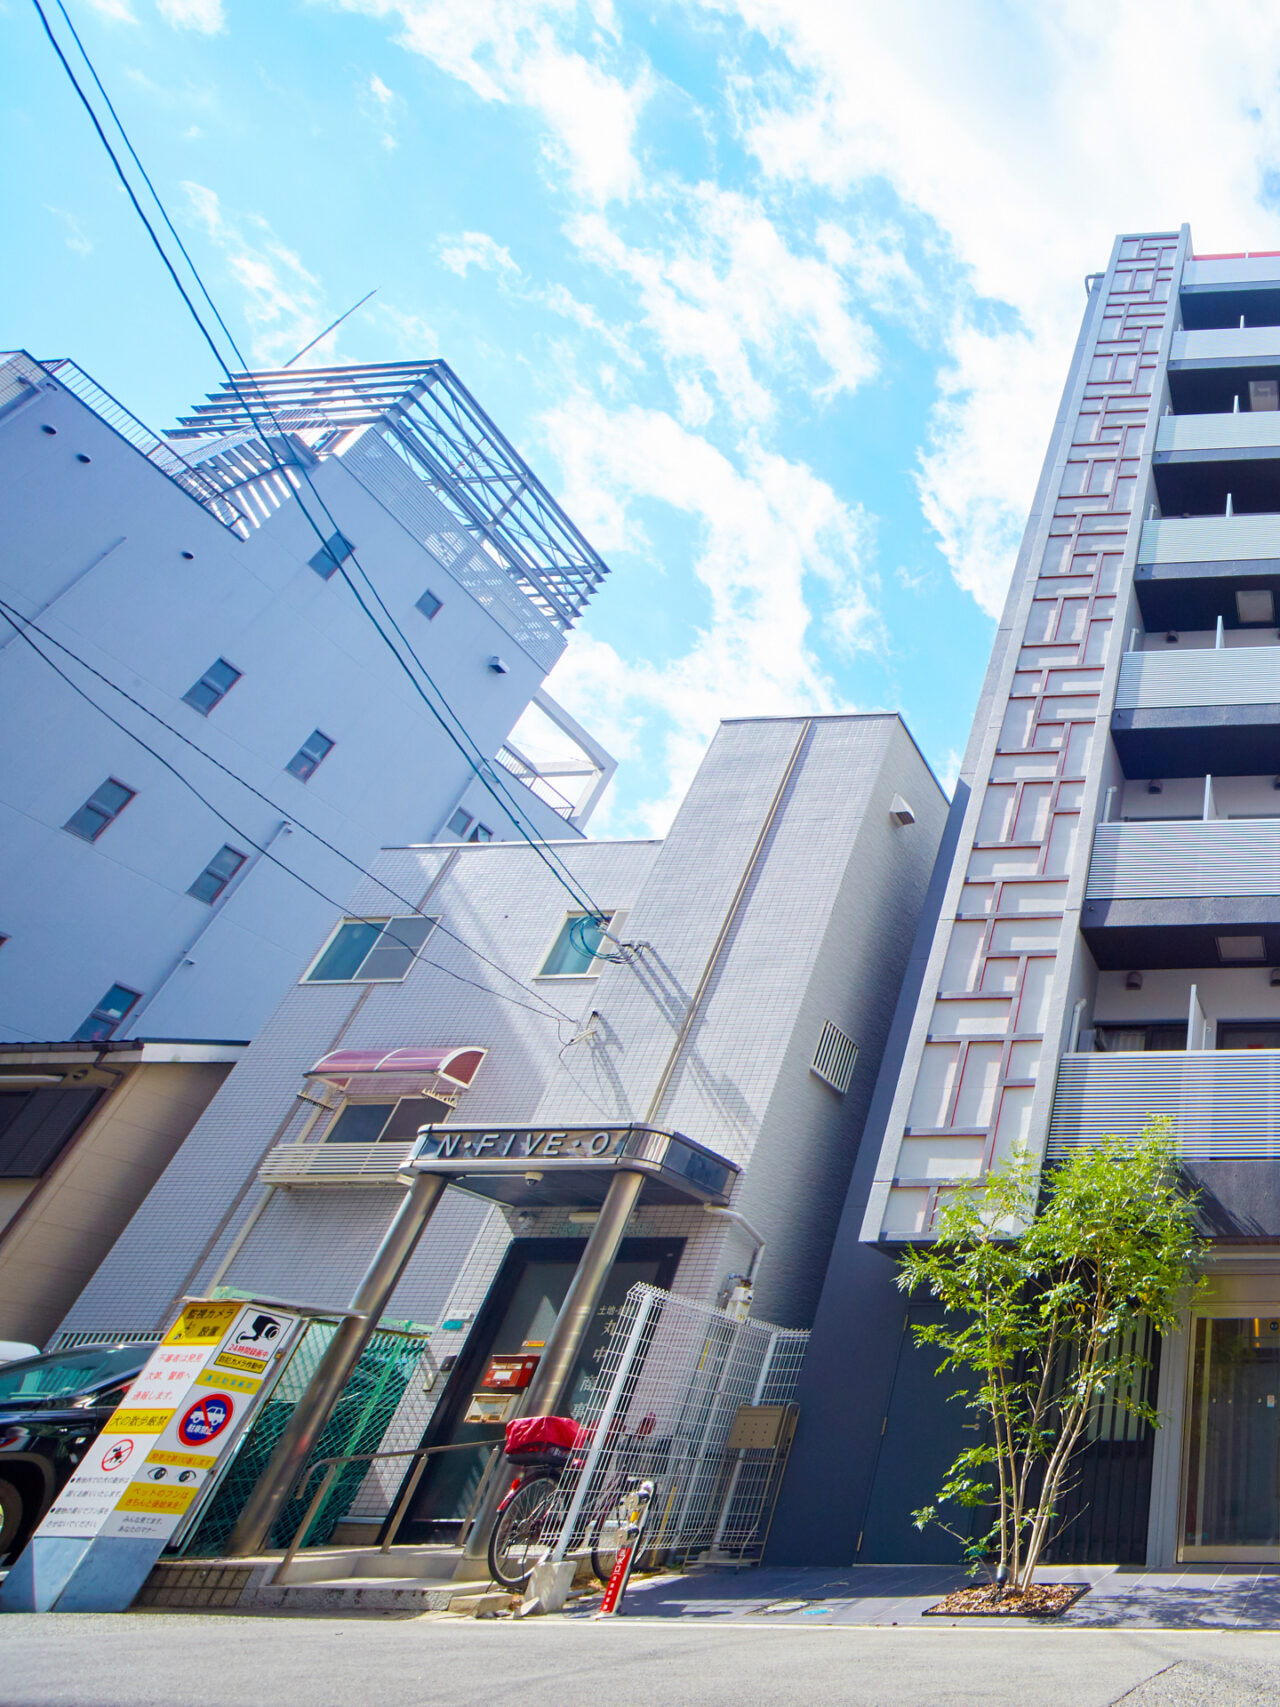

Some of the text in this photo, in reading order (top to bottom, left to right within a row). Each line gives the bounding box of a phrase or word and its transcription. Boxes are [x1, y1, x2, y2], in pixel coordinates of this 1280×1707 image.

[186, 1308, 234, 1320] 監視カメラ
[197, 1325, 220, 1337] 設置
[218, 1355, 264, 1371] 防犯カメラ作動中
[109, 1415, 168, 1427] 犬の散歩厳禁
[186, 1424, 215, 1436] 駐車禁止
